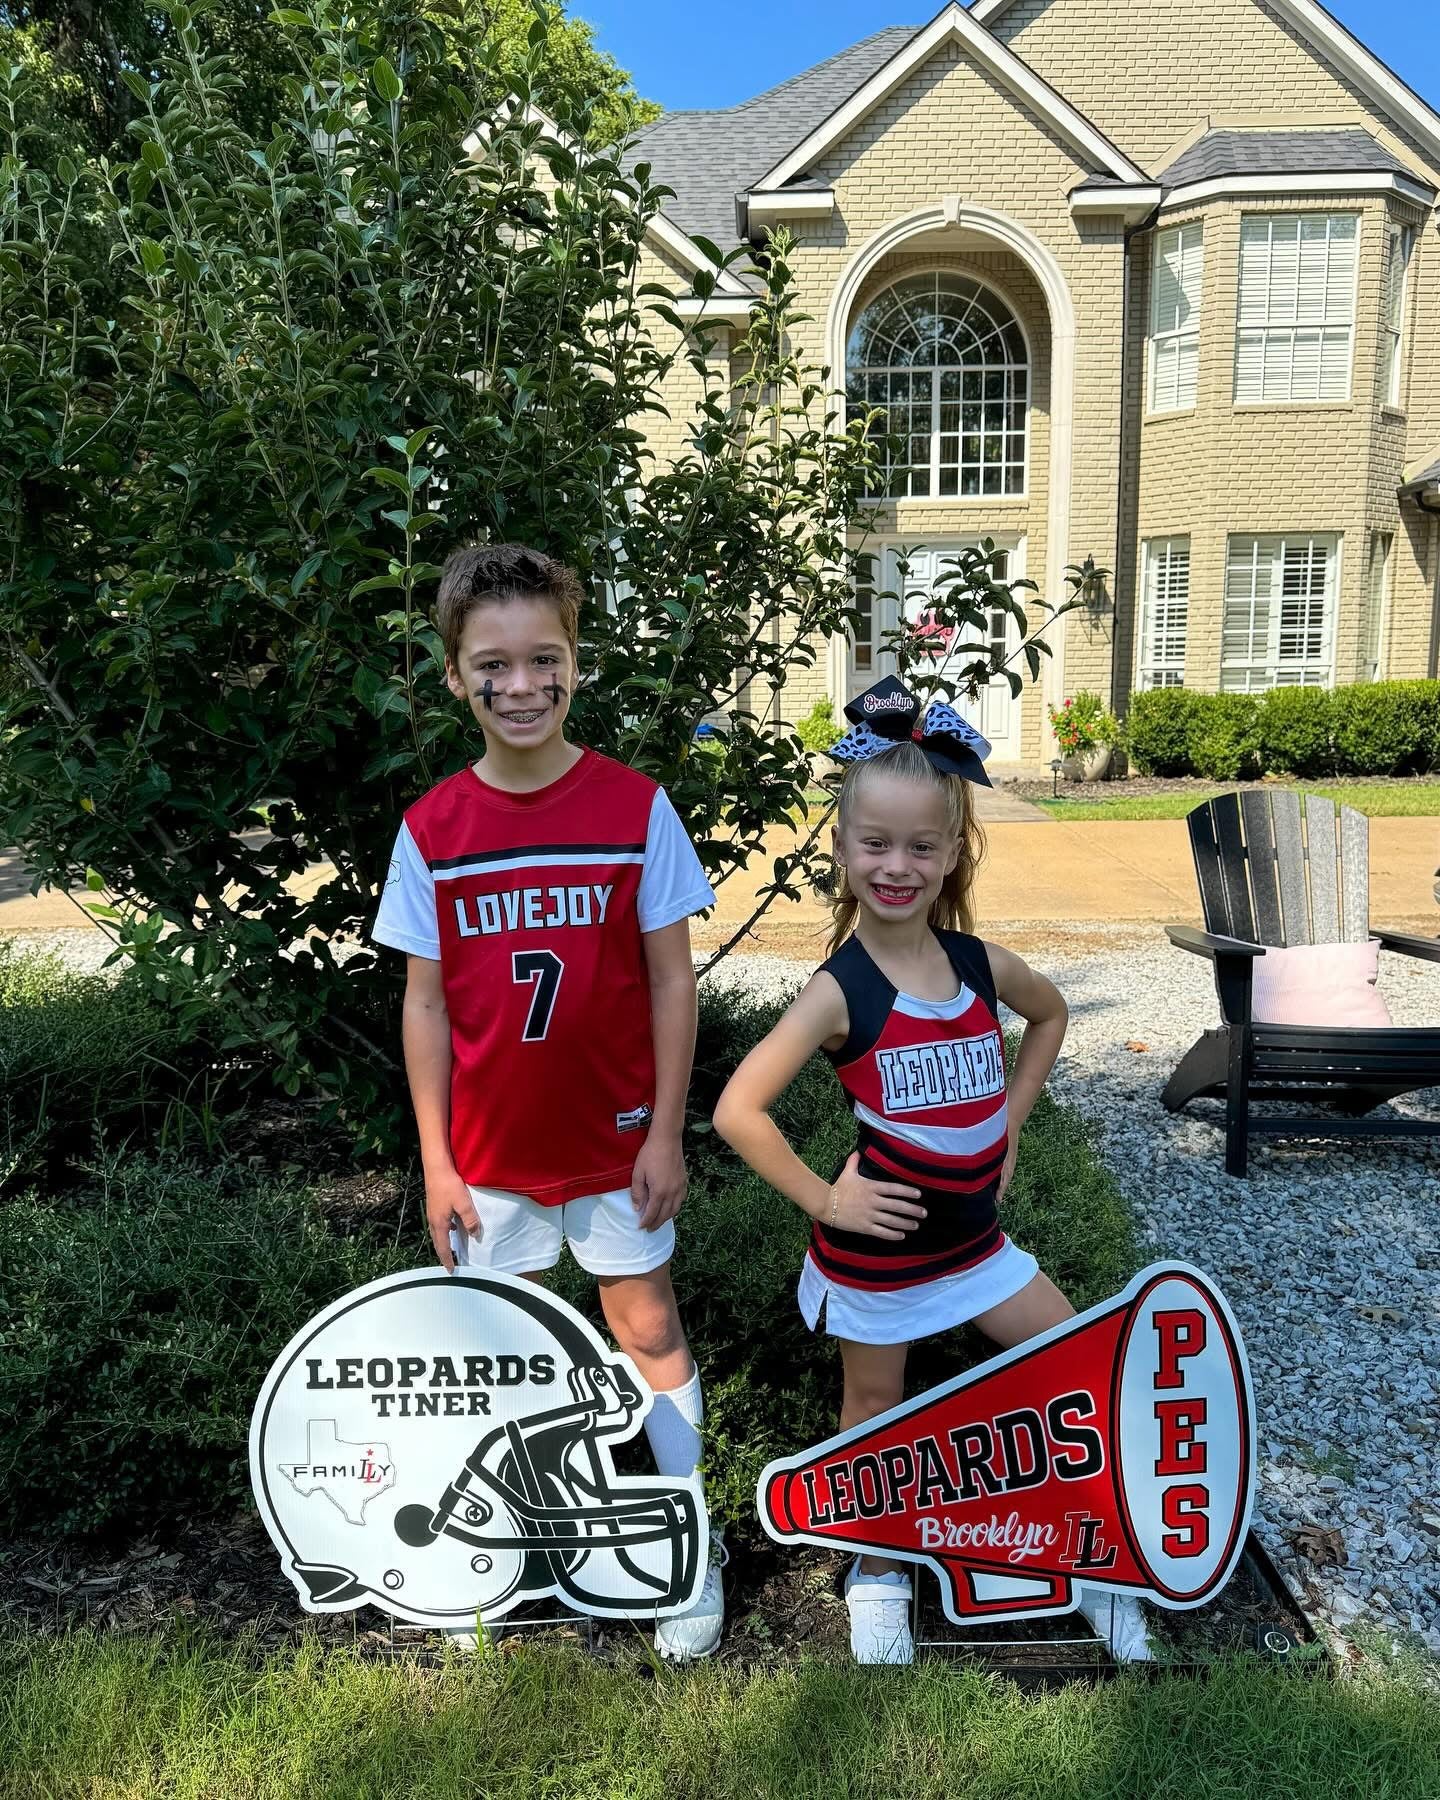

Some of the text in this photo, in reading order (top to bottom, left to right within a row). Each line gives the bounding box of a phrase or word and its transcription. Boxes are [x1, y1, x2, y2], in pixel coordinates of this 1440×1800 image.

[863, 691, 915, 714] Brooklyn
[453, 884, 615, 938] LOVEJOY
[511, 949, 565, 1043] 7
[305, 1354, 556, 1390] LEOPARDS
[371, 1391, 492, 1418] TINER
[802, 1388, 1104, 1528] LEOPARDS
[914, 1511, 1060, 1565] Brooklyn
